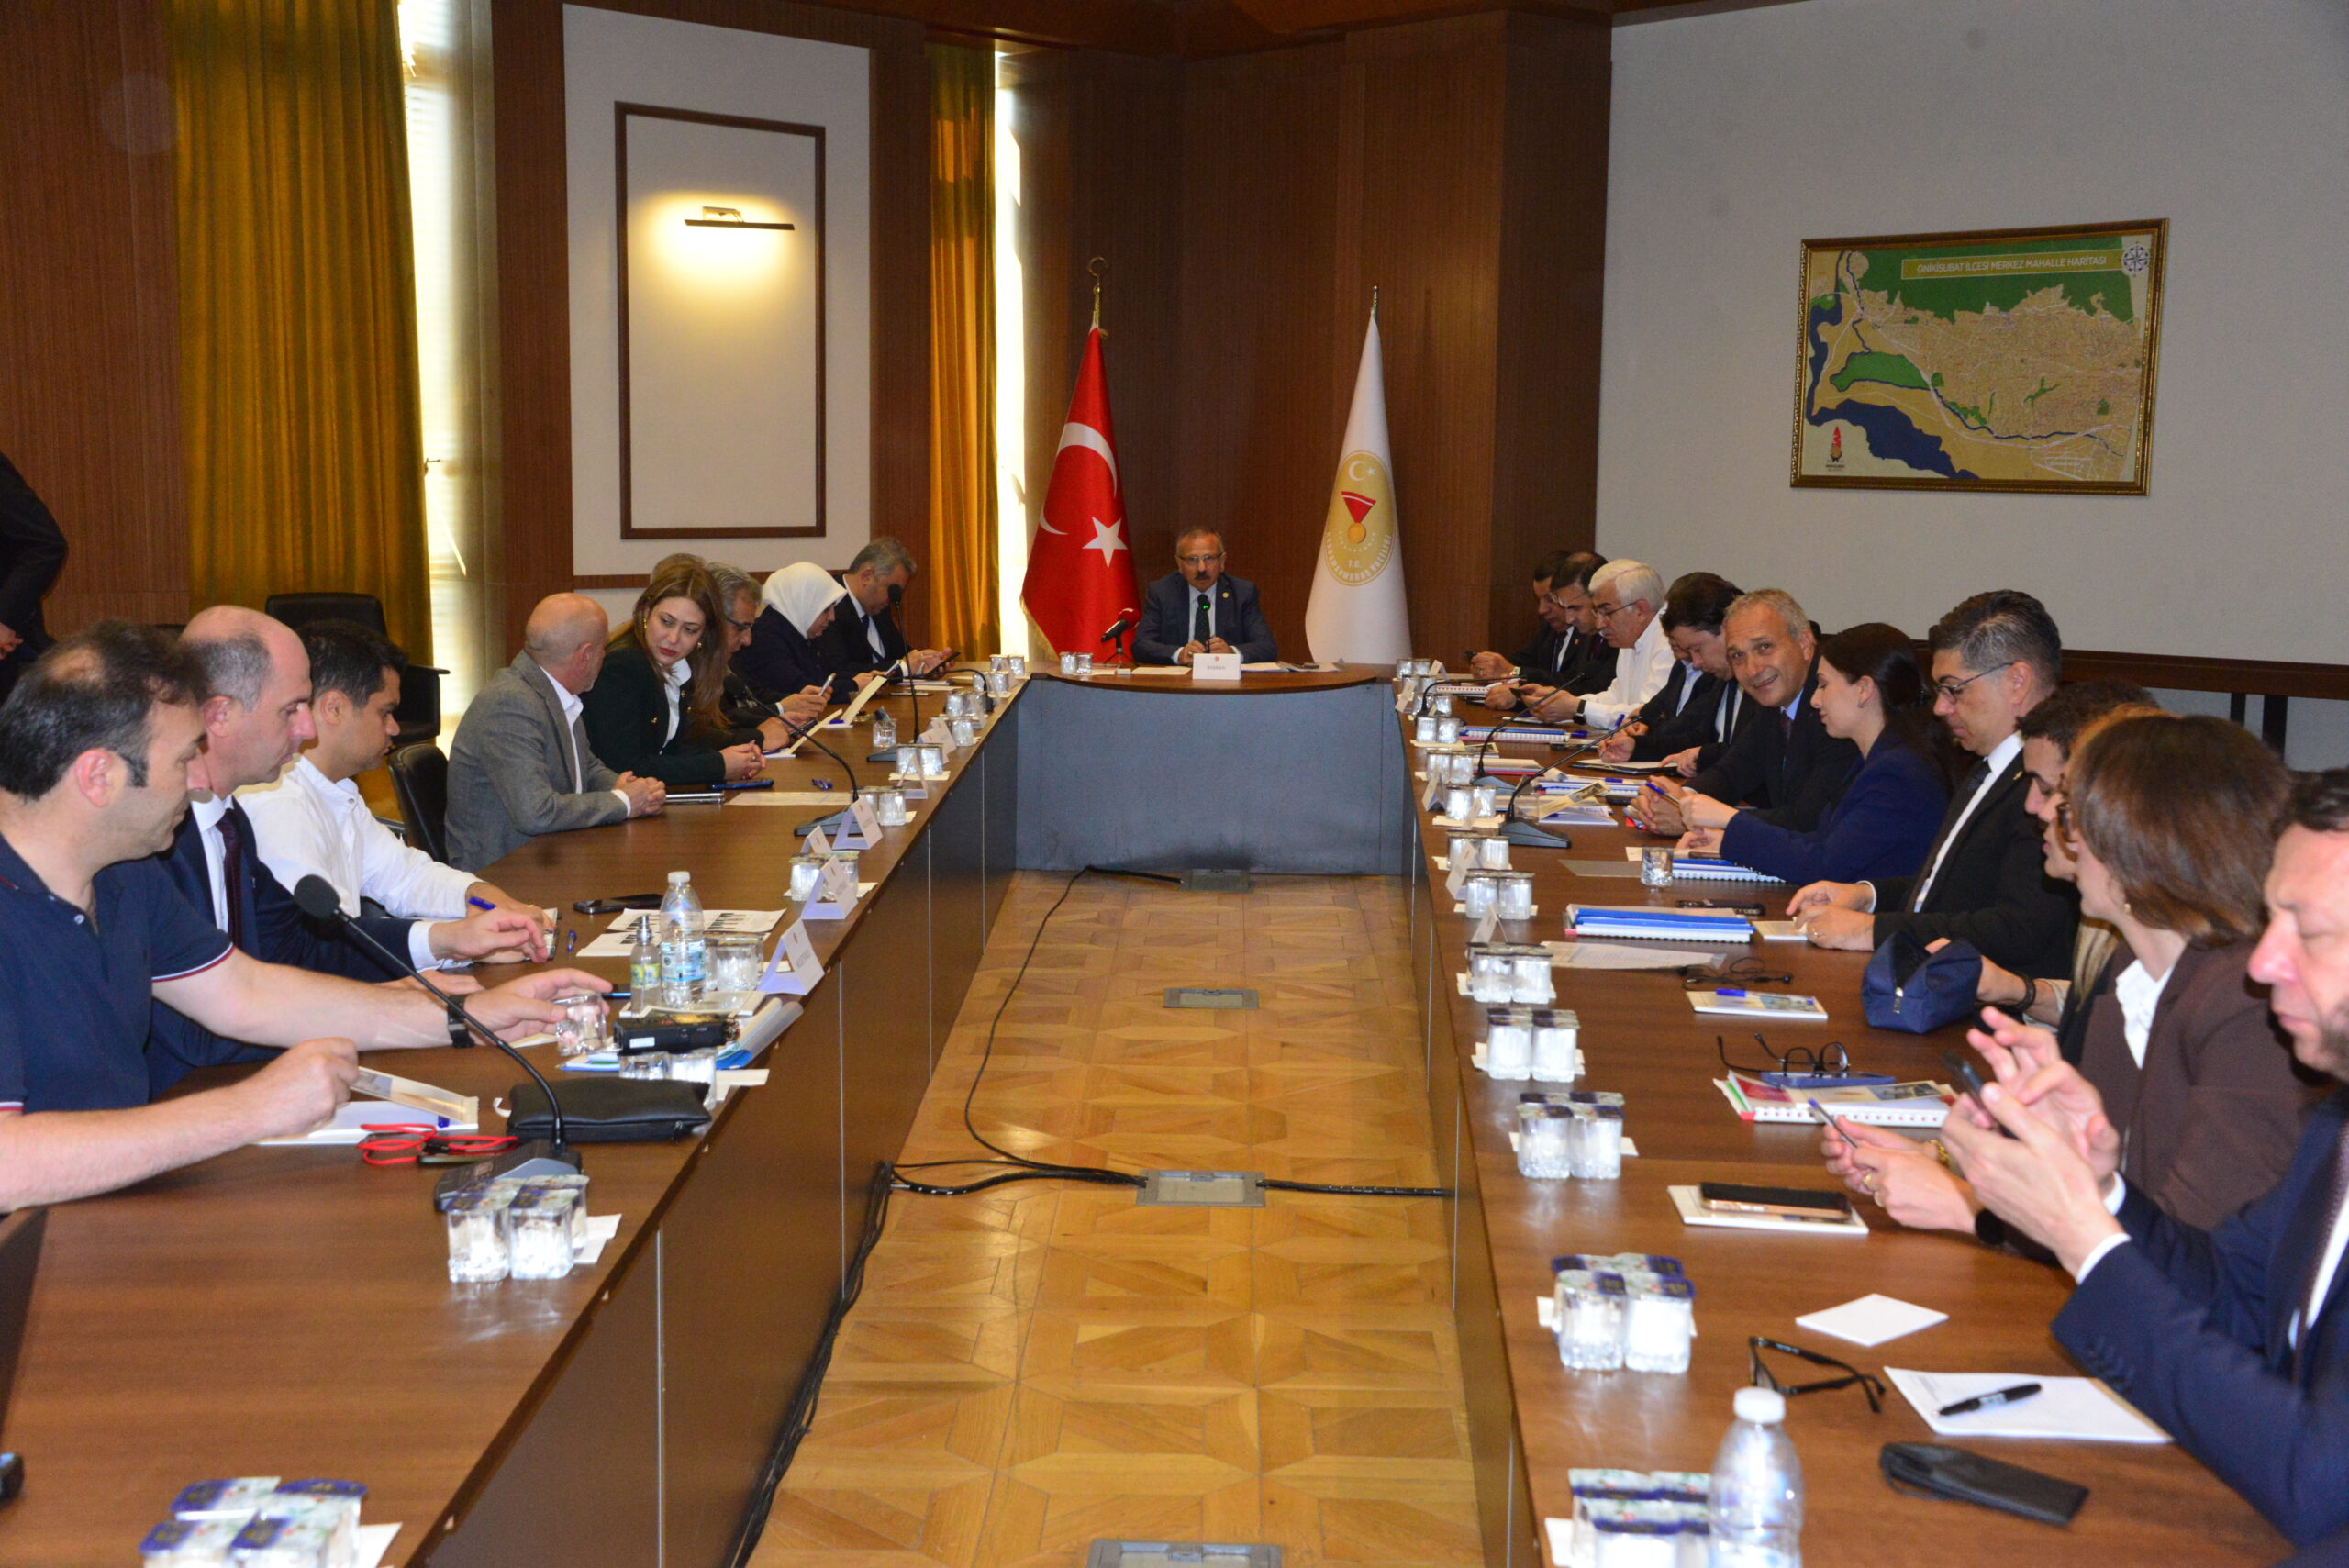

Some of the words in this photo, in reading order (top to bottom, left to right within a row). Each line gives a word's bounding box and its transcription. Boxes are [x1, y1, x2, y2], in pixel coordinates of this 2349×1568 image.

[1991, 259, 2024, 270] MERKEZ
[2025, 257, 2065, 268] MAHALLE
[2067, 255, 2107, 266] HARİTASI
